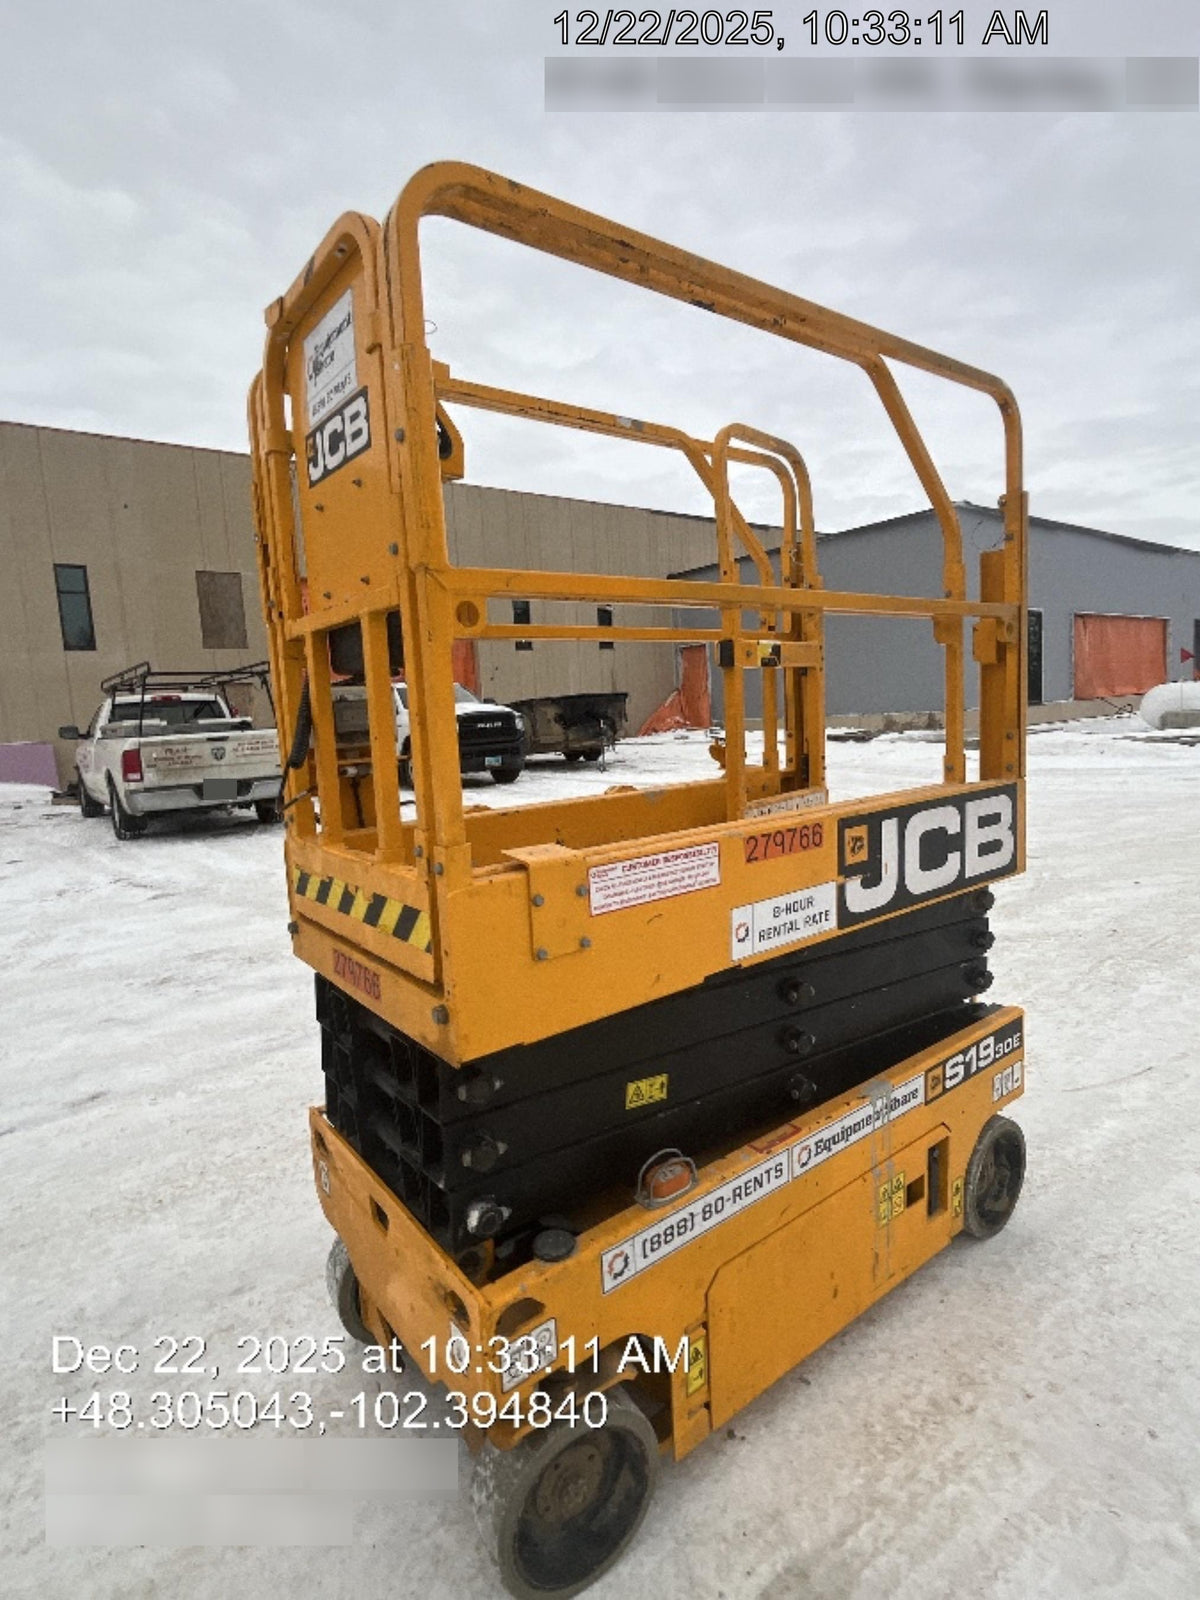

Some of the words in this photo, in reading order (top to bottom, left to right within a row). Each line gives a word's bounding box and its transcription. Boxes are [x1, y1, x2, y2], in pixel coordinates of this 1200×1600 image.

[308, 396, 369, 481] JCB
[746, 822, 823, 863] 279766
[845, 794, 1014, 913] JCB
[758, 919, 800, 943] RENTAL
[803, 909, 831, 926] RATE
[772, 895, 815, 919] 8-HOUR
[701, 1161, 784, 1223] 80-RENTS
